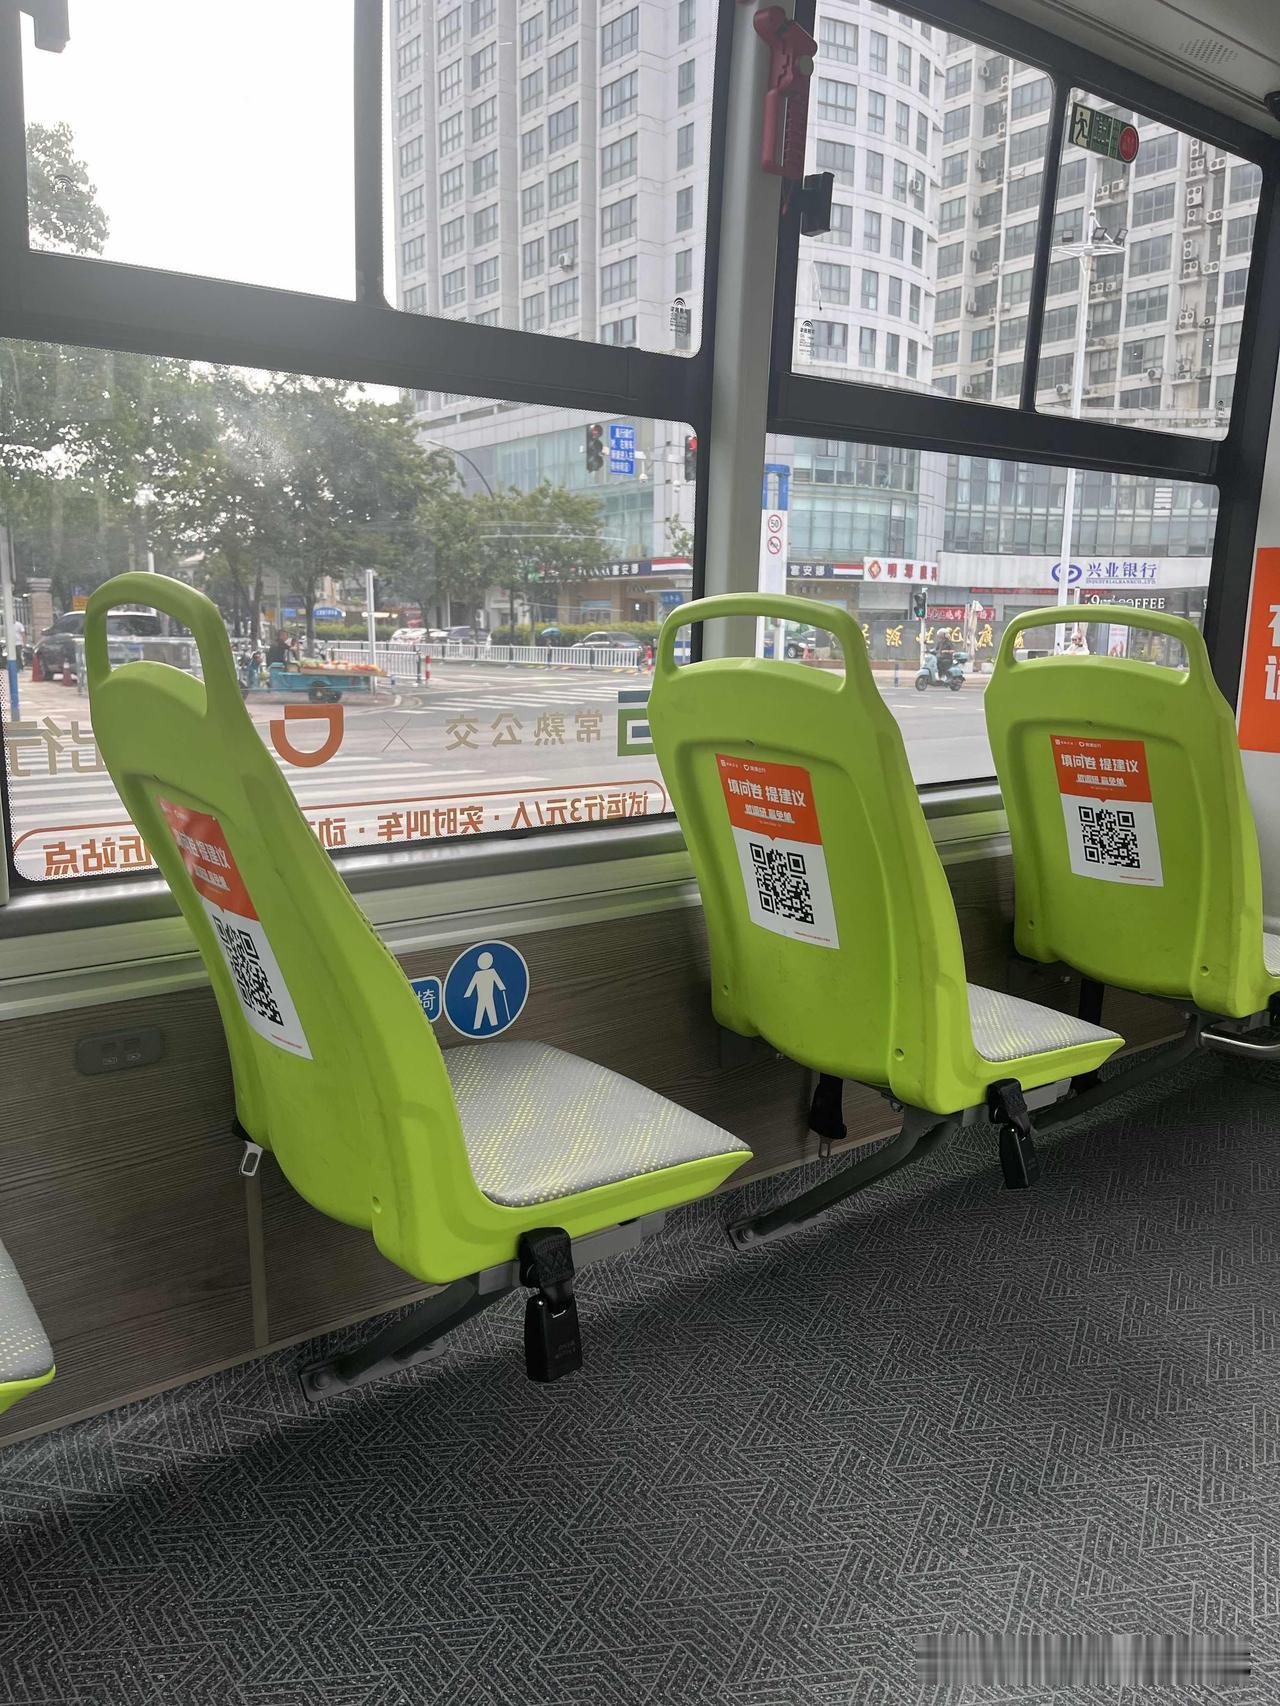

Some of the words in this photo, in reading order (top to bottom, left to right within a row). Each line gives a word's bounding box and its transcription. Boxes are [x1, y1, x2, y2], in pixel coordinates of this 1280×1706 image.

[770, 519, 780, 529] 50
[1086, 562, 1158, 578] 兴业银行
[1061, 753, 1097, 770] 填问卷
[1099, 757, 1139, 773] 提建议
[728, 778, 763, 800] 填问卷
[765, 785, 807, 807] 提建议
